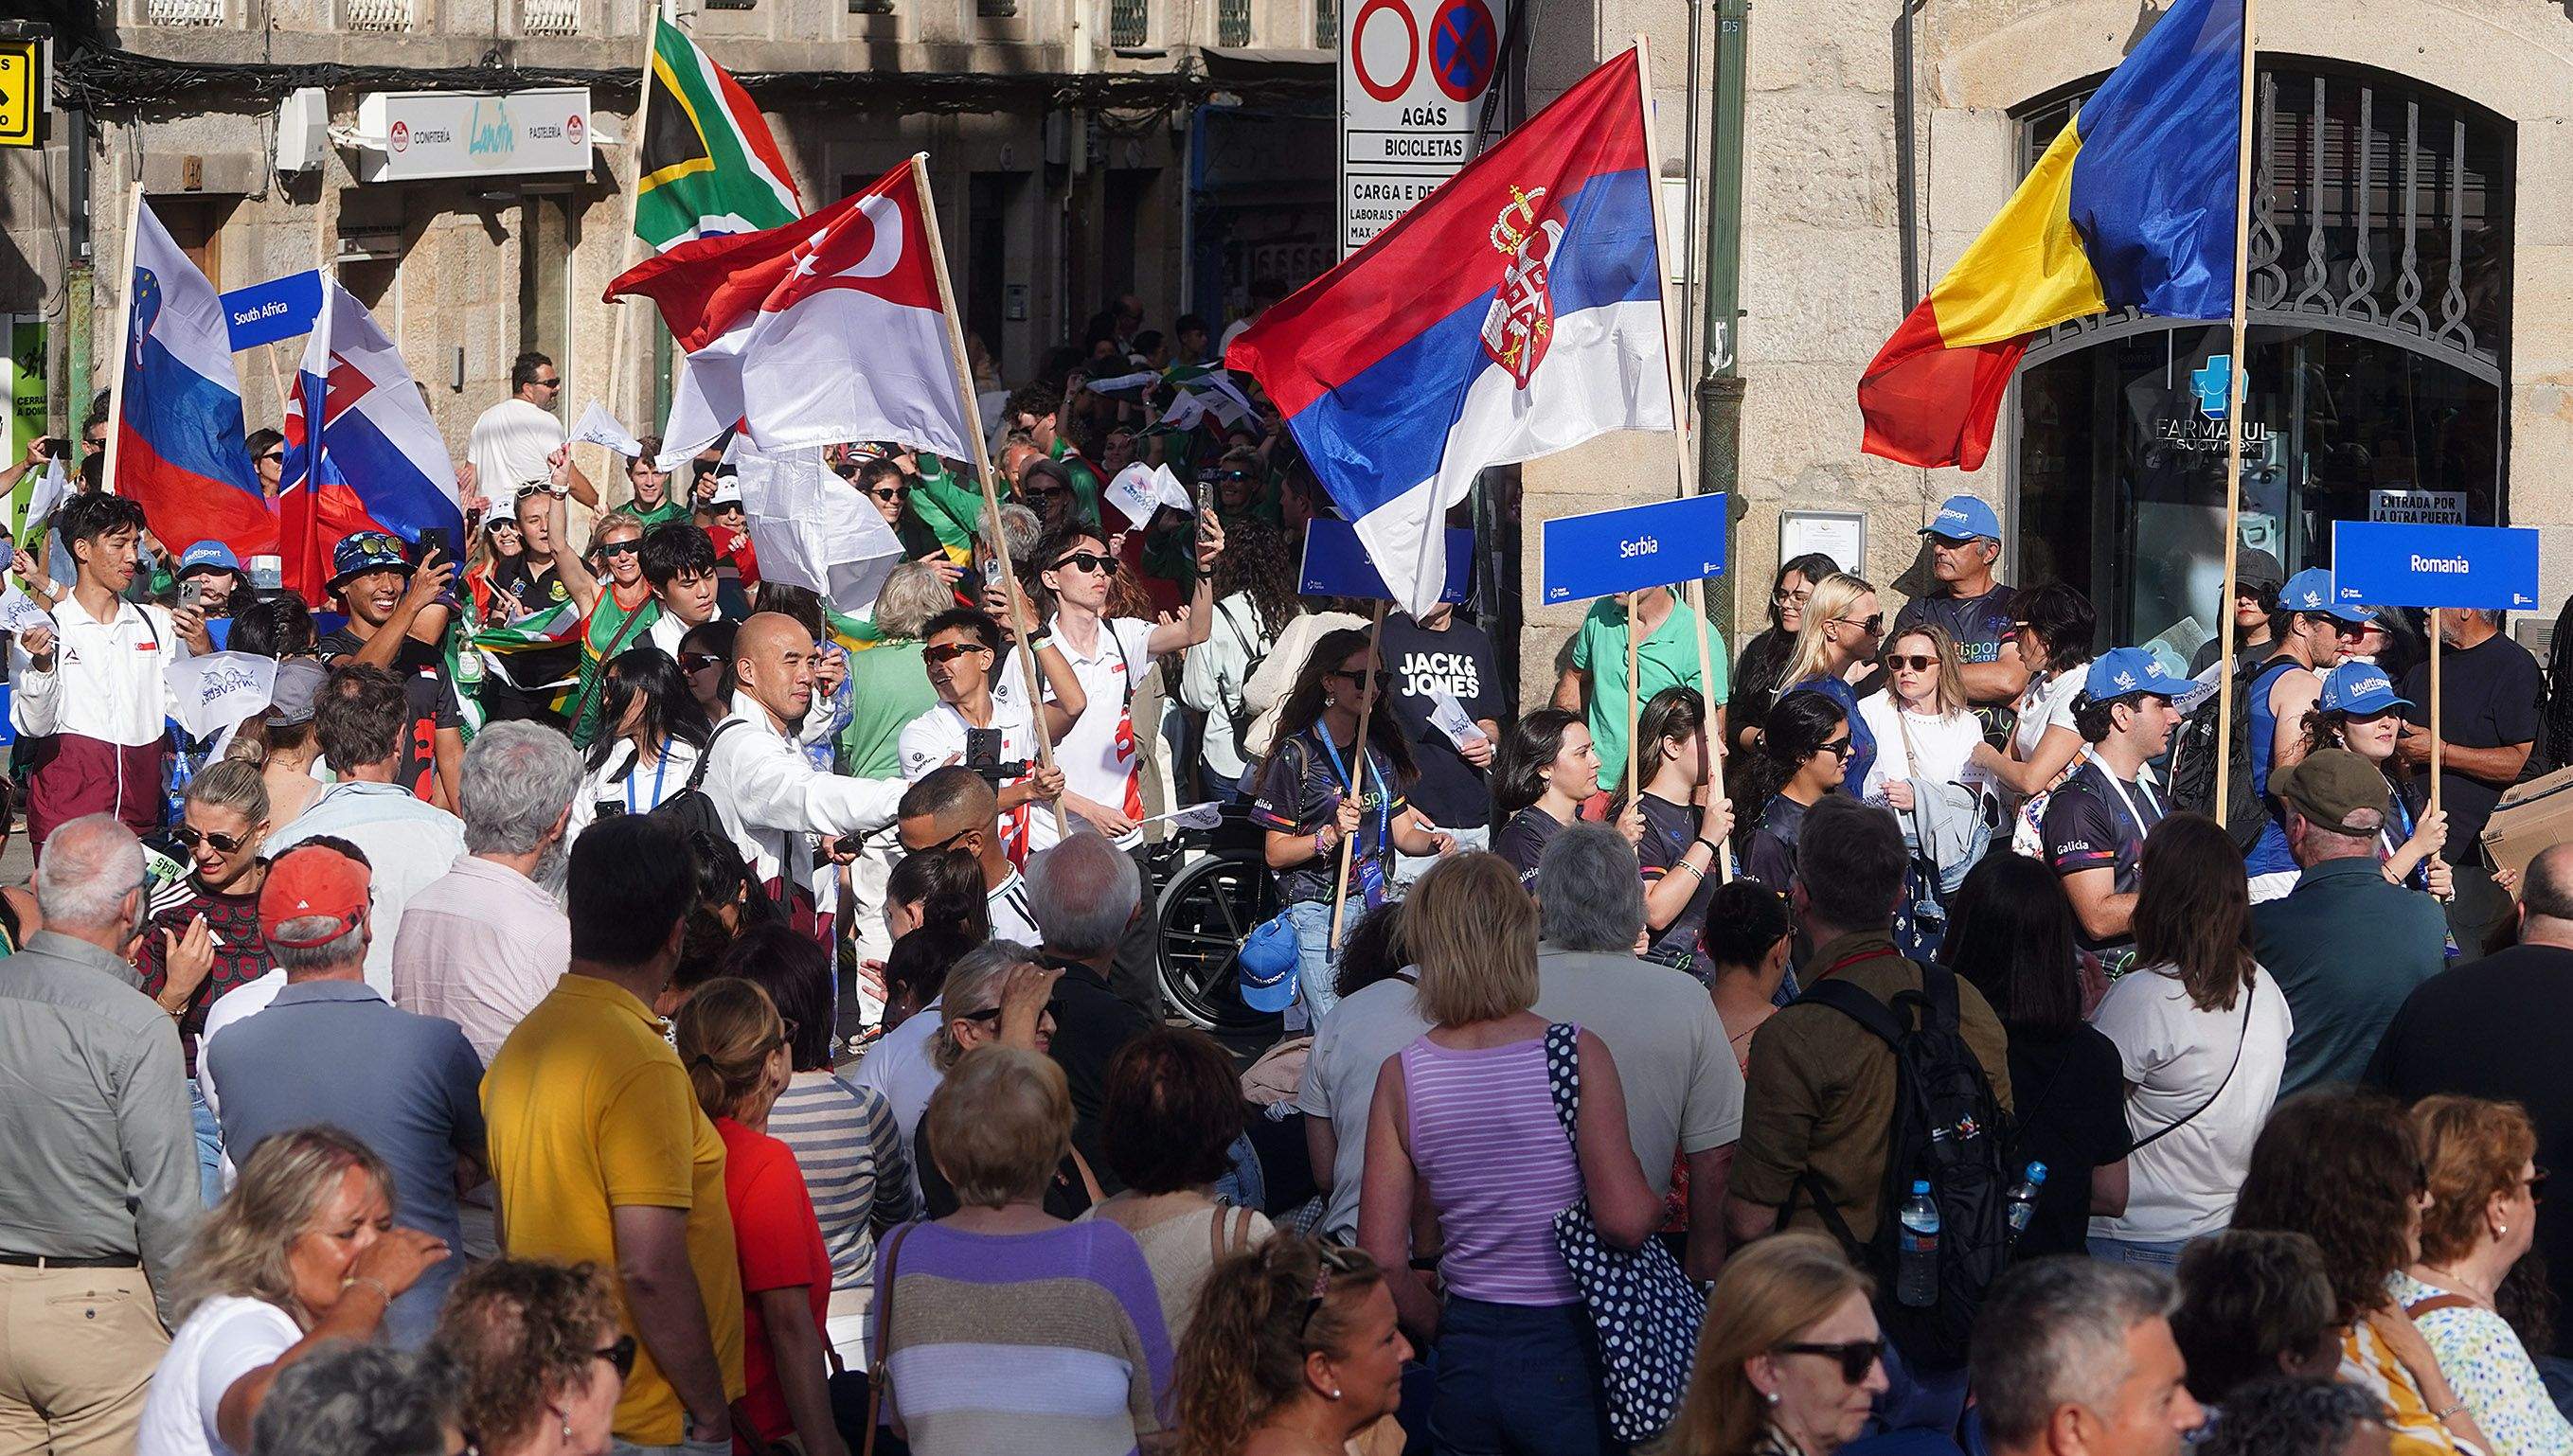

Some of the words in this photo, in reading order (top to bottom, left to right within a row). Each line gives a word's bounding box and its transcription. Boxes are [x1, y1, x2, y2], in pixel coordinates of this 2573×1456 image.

[1401, 101, 1447, 126] AGÁS
[414, 127, 451, 145] CONFITERÍA
[528, 123, 562, 139] PASTELERÍA
[1385, 139, 1463, 156] BICICLETAS
[1354, 184, 1401, 200] CARGA
[1405, 186, 1413, 200] E
[1418, 186, 1438, 200] DE
[1350, 209, 1394, 221] LABORAIS
[233, 307, 260, 326] South
[261, 301, 288, 319] Africa
[2155, 419, 2269, 441] FARMAUL
[2380, 496, 2431, 509] ENTRADA
[2433, 497, 2457, 510] POR
[2373, 510, 2388, 523] LA
[2389, 511, 2418, 523] OTRA
[2421, 512, 2463, 524] PUERTA
[1619, 535, 1658, 559] Serbia
[2411, 554, 2470, 574] Romania
[1401, 672, 1480, 699] JONES
[2056, 835, 2090, 855] Galicia
[155, 857, 180, 878] 1045
